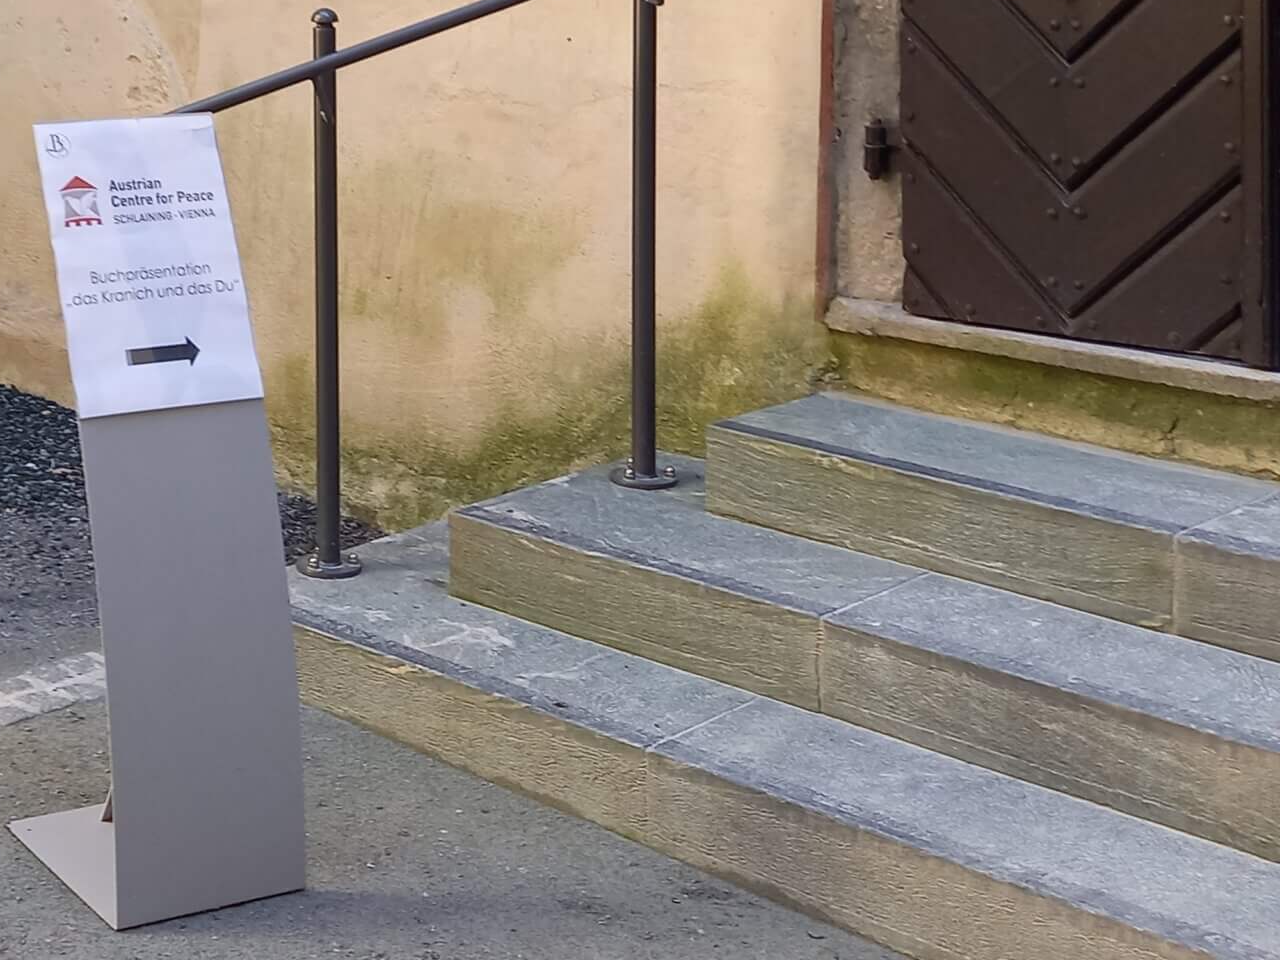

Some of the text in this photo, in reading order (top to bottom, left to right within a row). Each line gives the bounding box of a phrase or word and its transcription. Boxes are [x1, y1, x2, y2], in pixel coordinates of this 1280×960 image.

[109, 178, 162, 192] Austrian
[111, 191, 214, 208] Centre for Peace
[113, 211, 173, 224] SCHLAINING
[178, 208, 216, 219] VIENNA
[101, 287, 154, 303] Kranich
[157, 282, 185, 298] und
[187, 282, 213, 296] das
